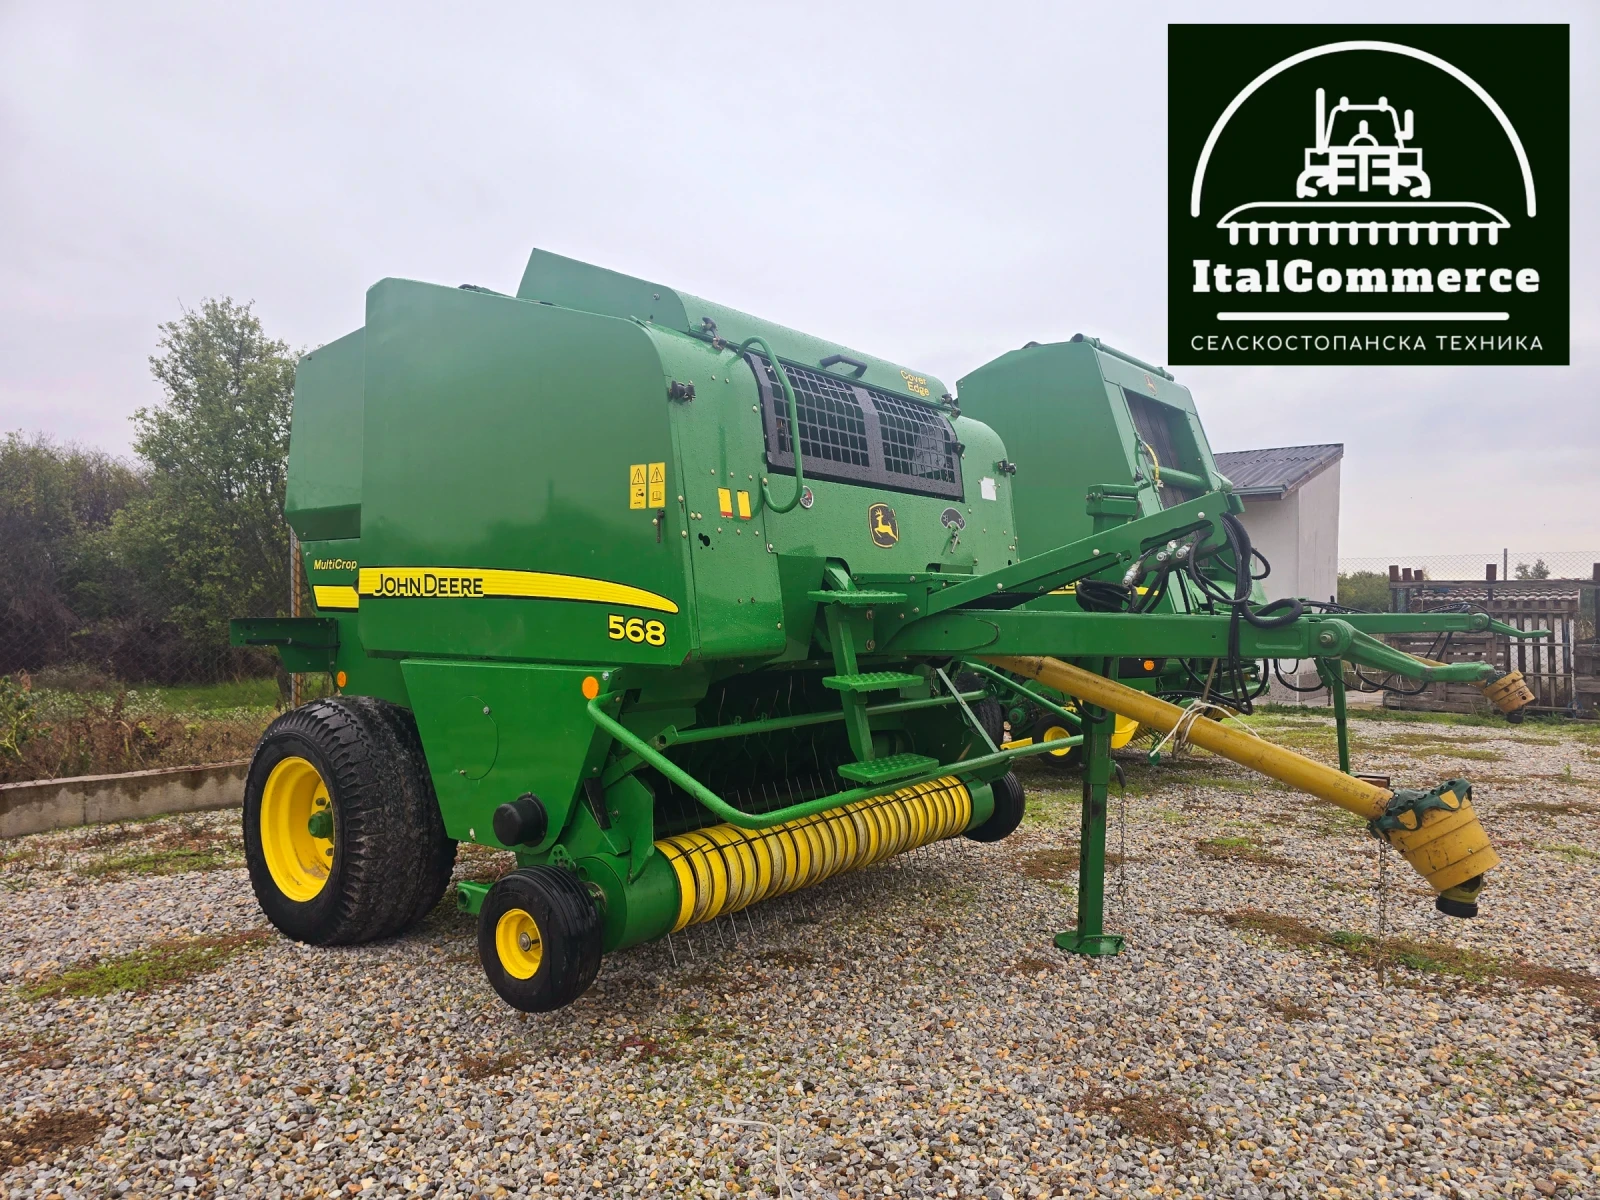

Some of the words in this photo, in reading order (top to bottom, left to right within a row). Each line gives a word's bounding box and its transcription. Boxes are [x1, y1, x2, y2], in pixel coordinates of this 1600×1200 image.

[900, 370, 927, 386] Cover
[907, 380, 930, 397] Edge
[313, 558, 358, 572] MultiCrop
[374, 573, 421, 596] JOHN
[424, 573, 484, 596] DEERE
[608, 613, 666, 647] 568
